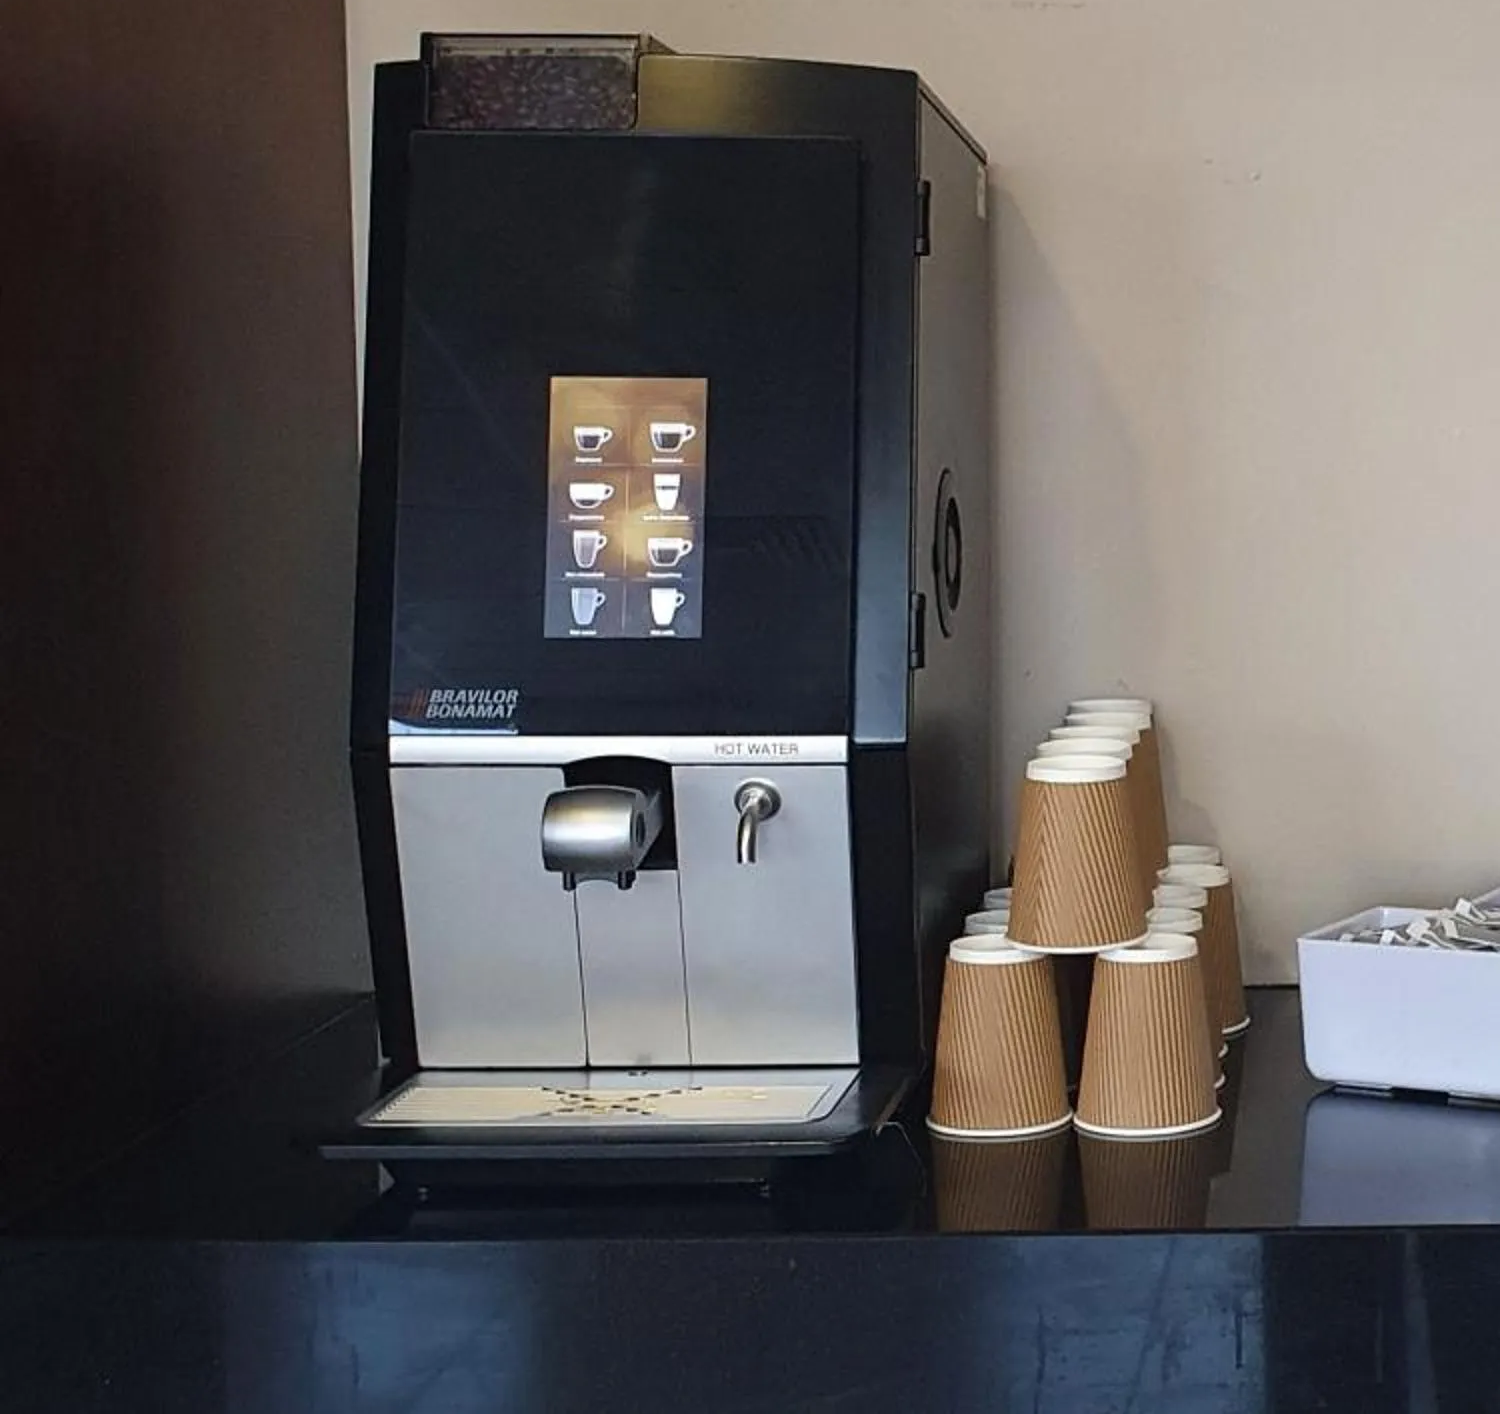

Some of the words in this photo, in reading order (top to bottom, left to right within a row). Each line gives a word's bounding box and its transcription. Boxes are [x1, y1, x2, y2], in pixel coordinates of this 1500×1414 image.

[429, 689, 519, 704] BRAVILOR
[426, 703, 515, 718] BONAMAT
[714, 743, 743, 755] HOT
[747, 742, 799, 755] WATER
